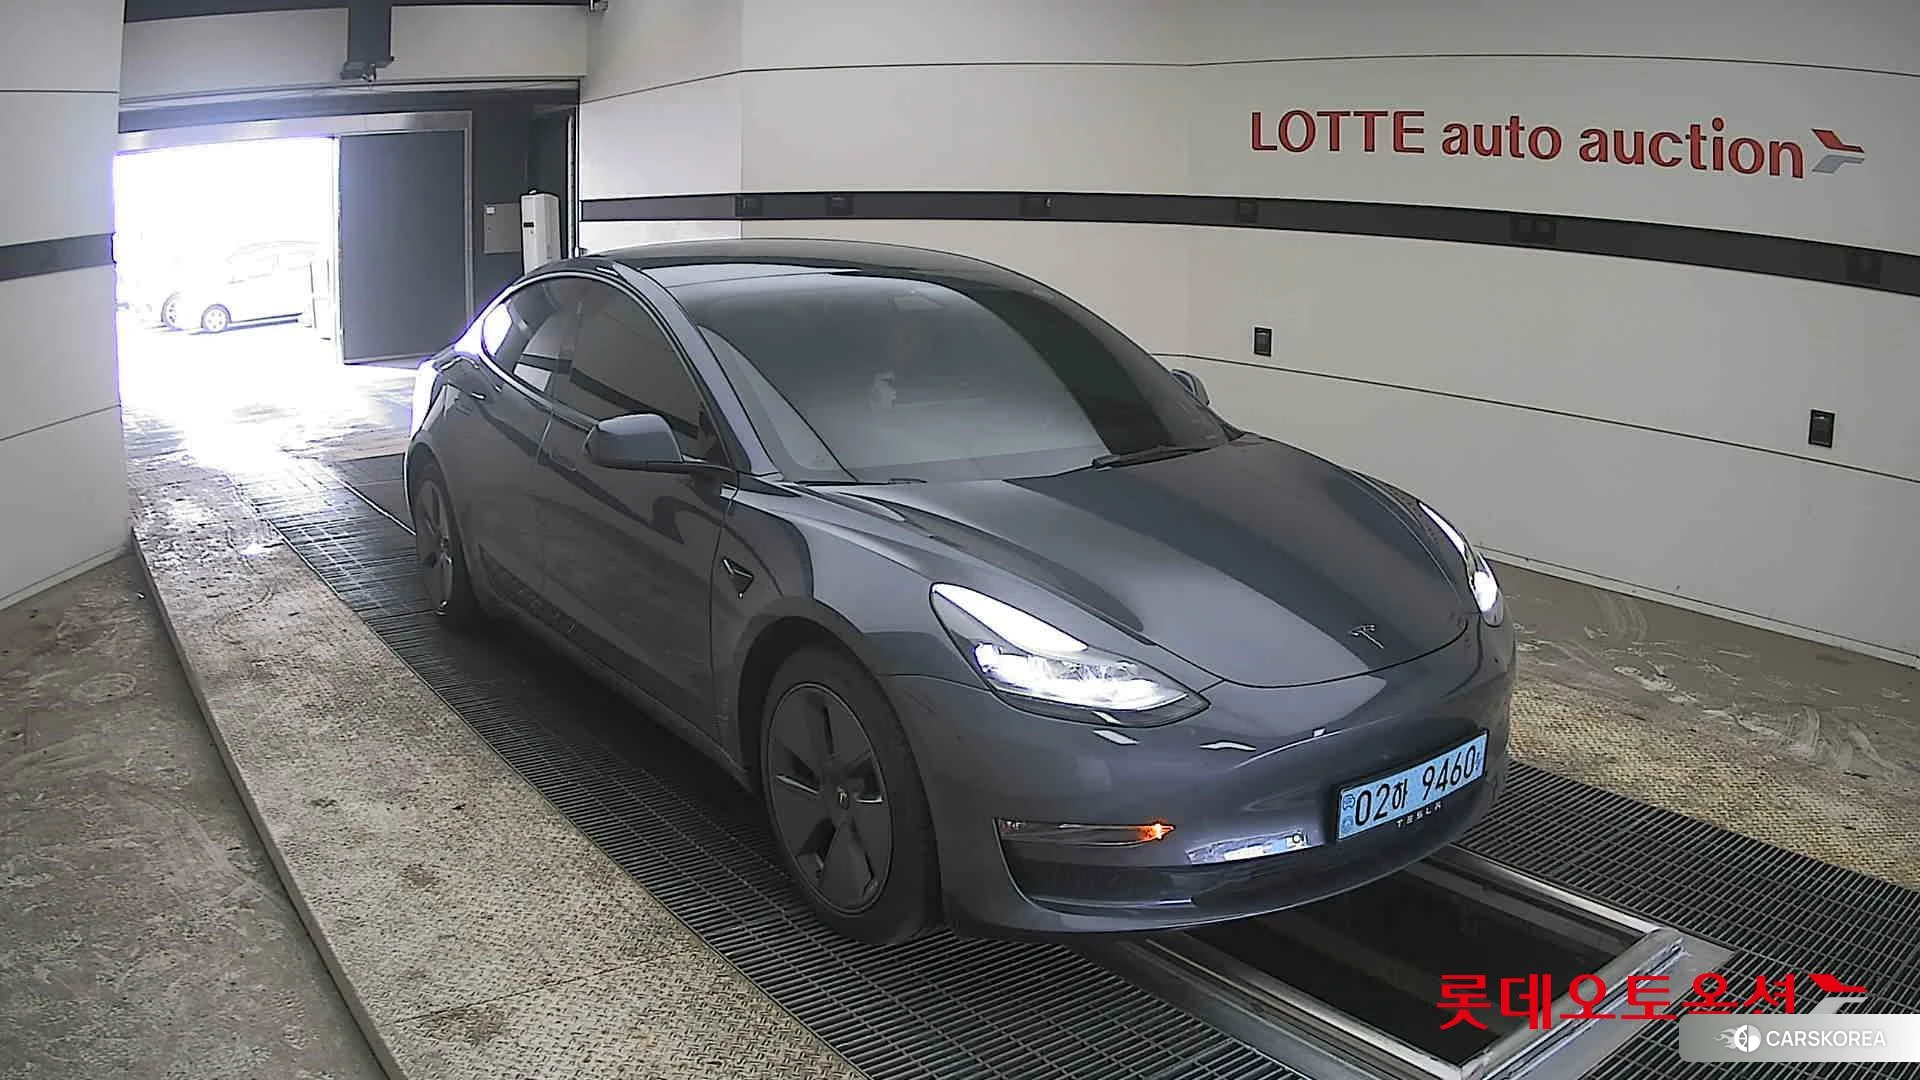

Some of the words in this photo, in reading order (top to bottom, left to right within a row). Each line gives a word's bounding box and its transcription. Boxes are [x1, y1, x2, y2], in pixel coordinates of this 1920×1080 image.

[1250, 111, 1425, 154] LOTTE
[1441, 116, 1562, 161] auto
[1579, 117, 1804, 179] auction
[1354, 778, 1408, 826] 02하
[1422, 745, 1476, 800] 9460
[1396, 801, 1442, 828] TESLA
